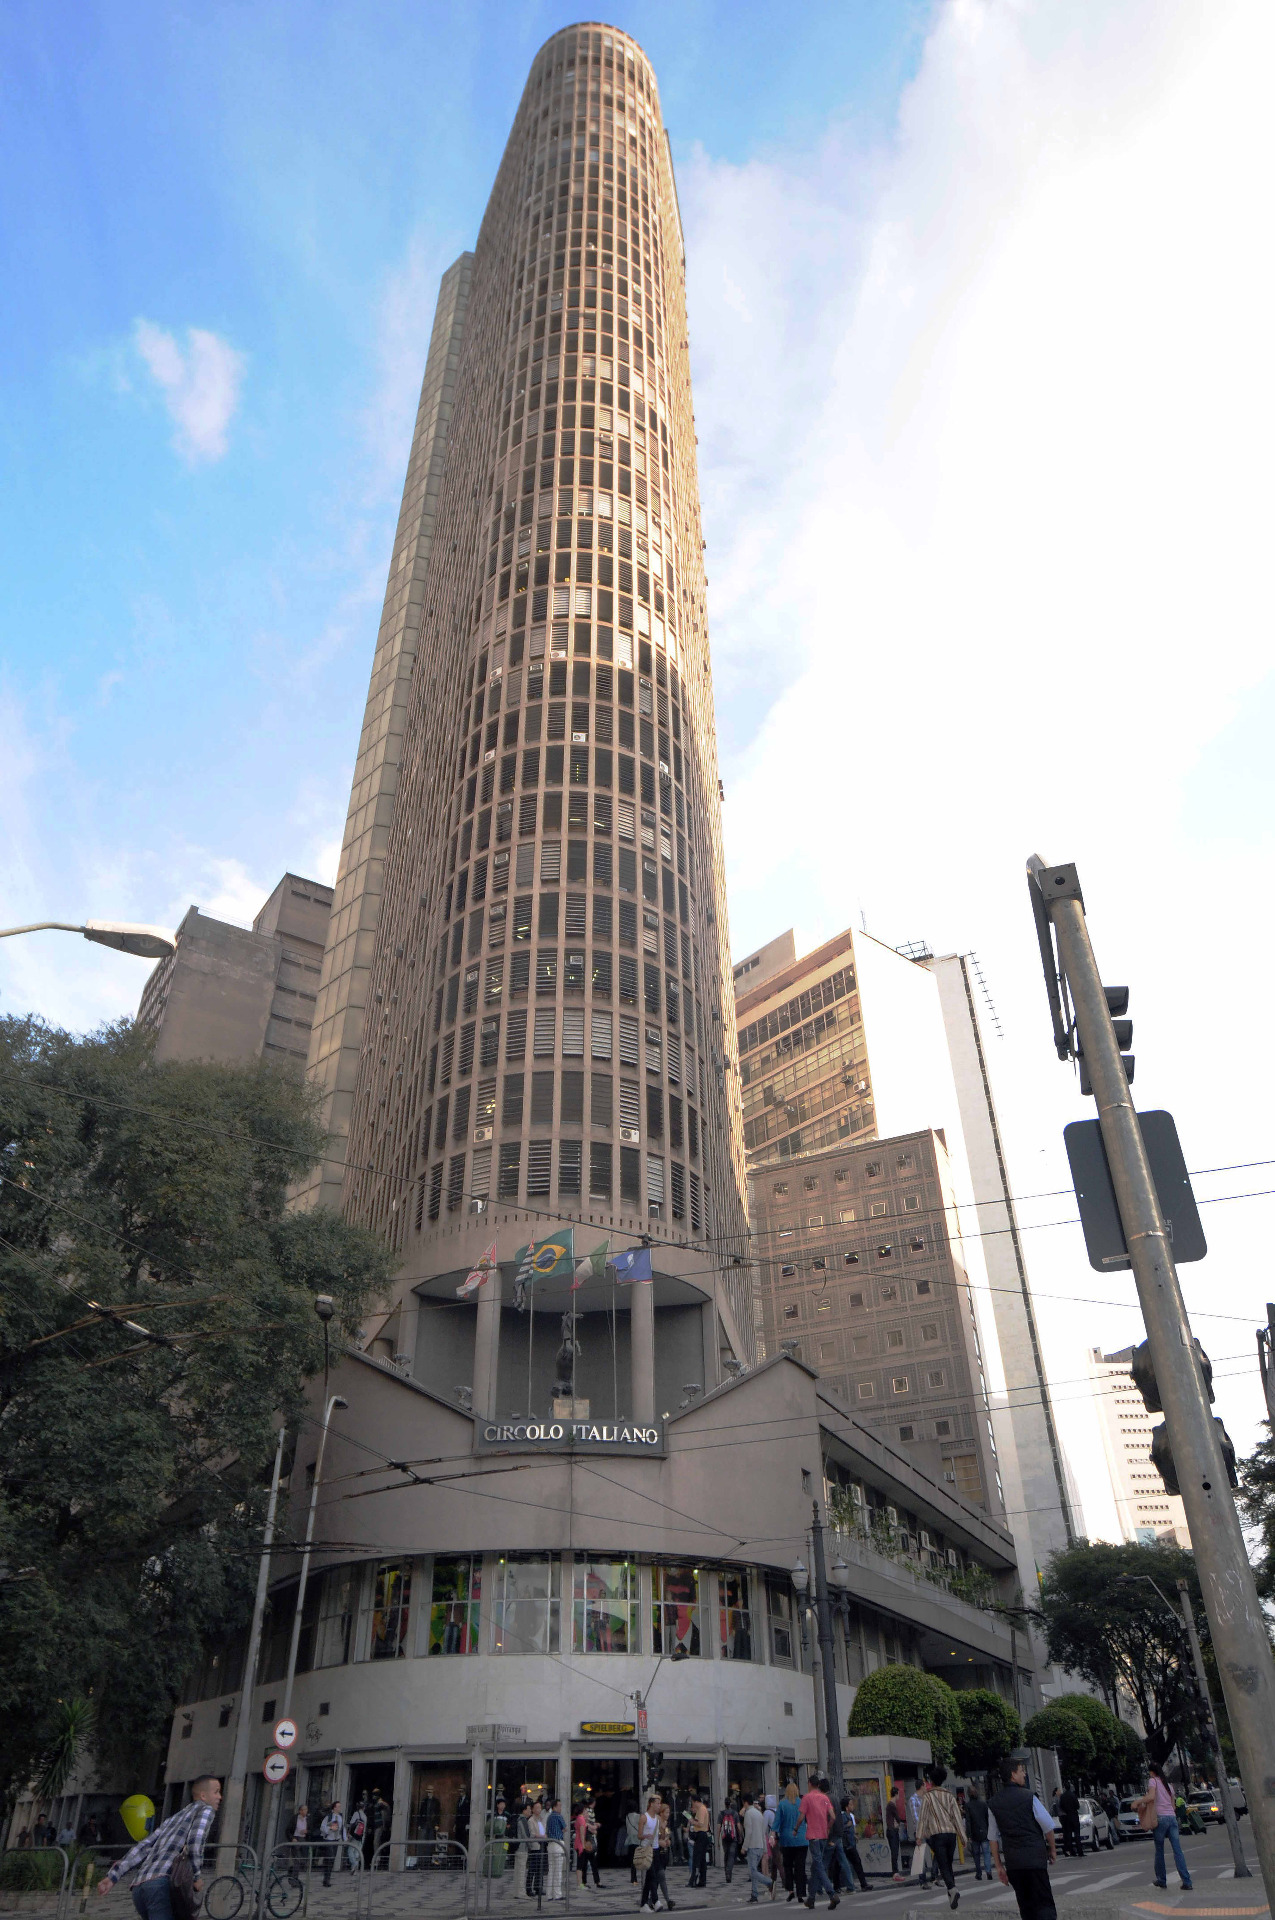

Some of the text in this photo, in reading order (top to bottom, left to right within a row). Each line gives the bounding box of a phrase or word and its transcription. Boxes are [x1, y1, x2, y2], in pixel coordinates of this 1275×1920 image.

[483, 1424, 659, 1444] CIRCOLO ITALIANO
[589, 1724, 627, 1733] SPIELBERG
